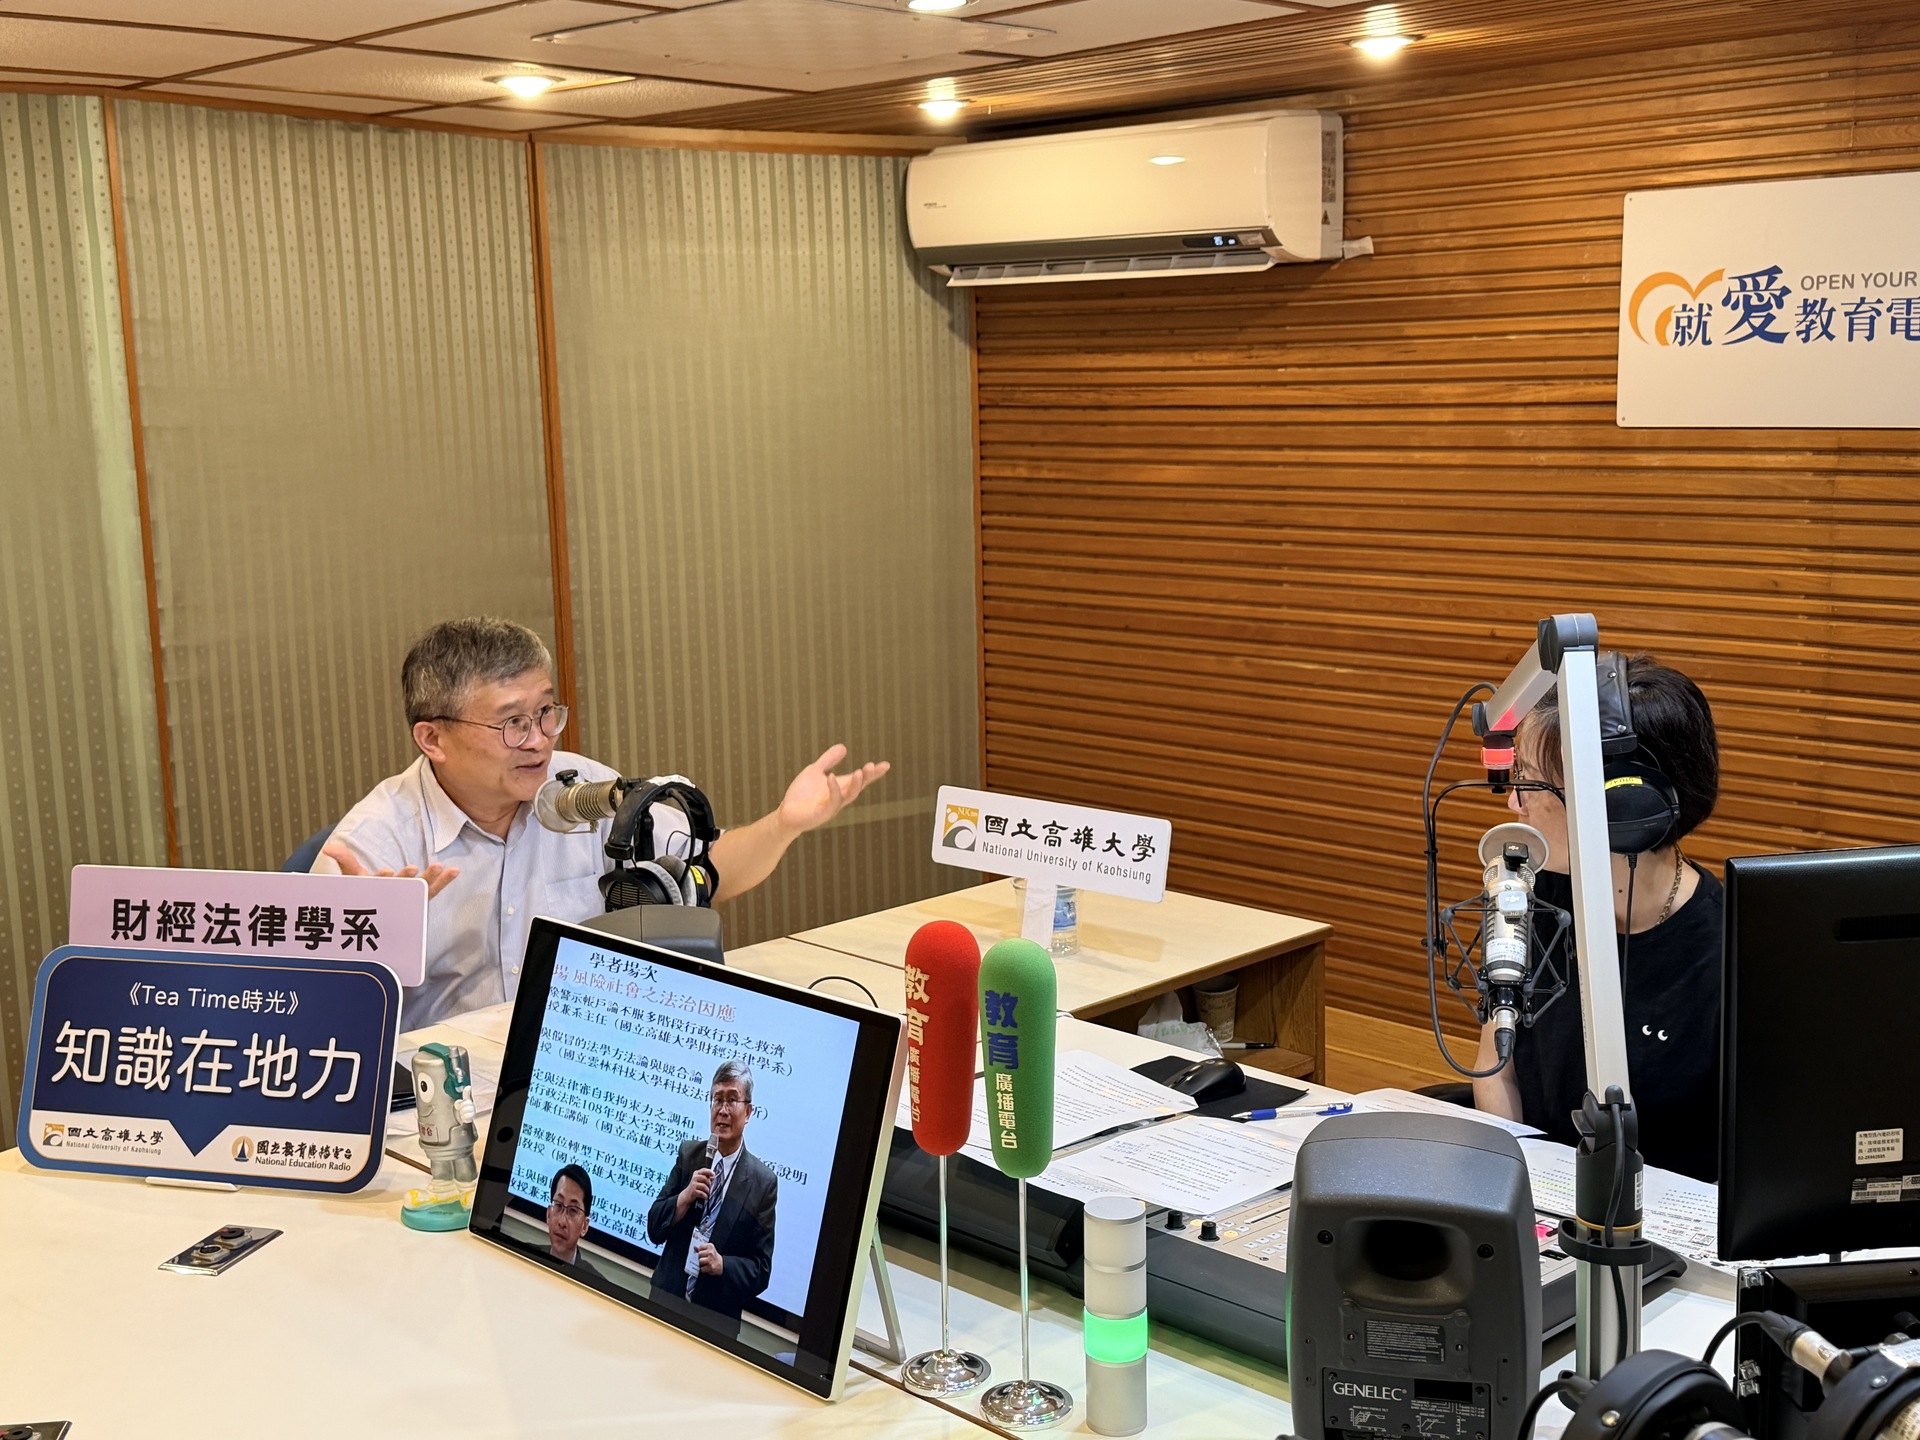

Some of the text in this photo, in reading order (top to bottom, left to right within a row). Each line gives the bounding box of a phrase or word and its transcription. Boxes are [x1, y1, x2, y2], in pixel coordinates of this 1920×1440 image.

[1800, 271, 1917, 291] OPEN YOUR
[984, 815, 1156, 862] 國立高雄大學
[982, 841, 1152, 884] National University of Kaohsiung
[111, 898, 381, 952] 財經法律學系
[589, 952, 658, 983] 學者場次
[573, 969, 737, 1023] 風險社會之法治因應
[984, 990, 1019, 1070] 教育
[51, 1020, 362, 1103] 知識在地力
[540, 1041, 711, 1102] 授（國立雲林科技大學科技法
[527, 1097, 679, 1157] 師兼任講師（國立高雄大學
[995, 1072, 1018, 1149] 廣播電台
[66, 1140, 90, 1149] National
[92, 1143, 121, 1152] University
[68, 1127, 164, 1146] 國立高雄大學
[255, 1156, 352, 1172] National Education Radio
[514, 1164, 552, 1189] 主與國
[518, 1136, 661, 1197] 教授（國立高雄大學政治
[1333, 1382, 1402, 1401] GENELEC
